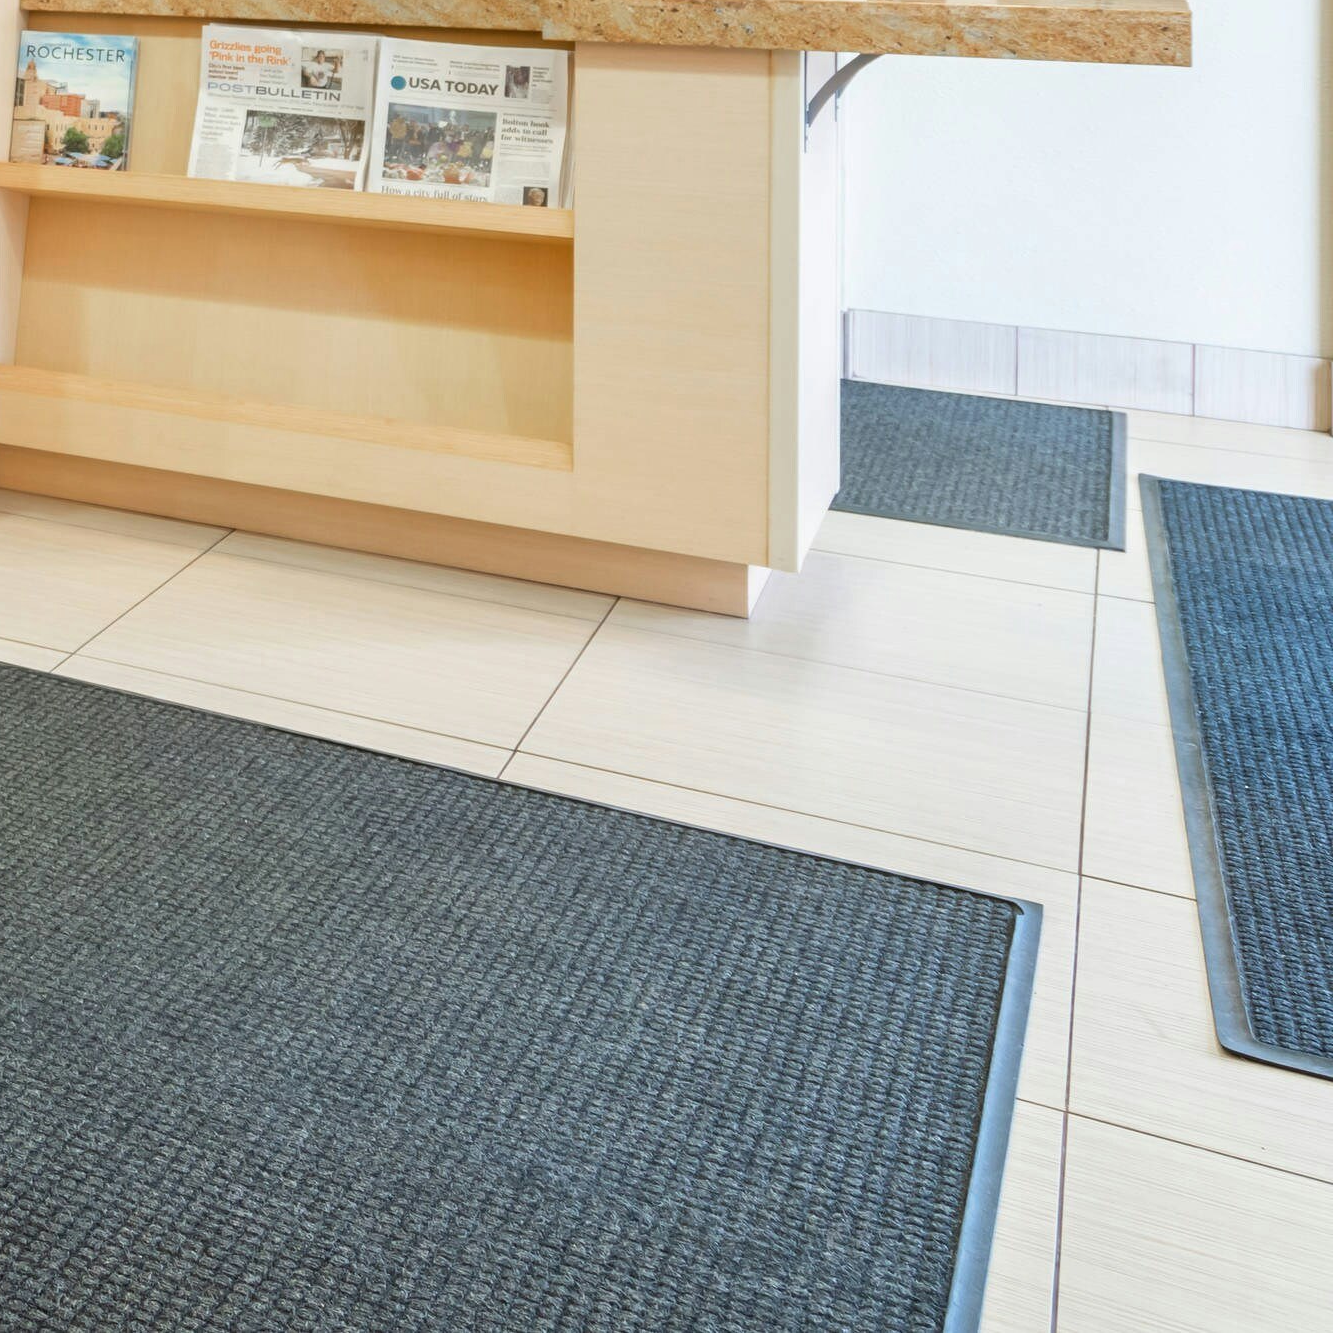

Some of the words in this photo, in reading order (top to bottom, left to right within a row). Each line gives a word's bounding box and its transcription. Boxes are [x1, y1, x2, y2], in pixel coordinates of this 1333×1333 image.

[26, 45, 126, 63] ROCHESTER
[209, 40, 253, 53] Grizzlies
[254, 44, 282, 56] going
[236, 53, 245, 62] in
[247, 53, 264, 64] the
[409, 77, 441, 91] USA
[444, 80, 499, 96] TODAY
[381, 185, 402, 197] How
